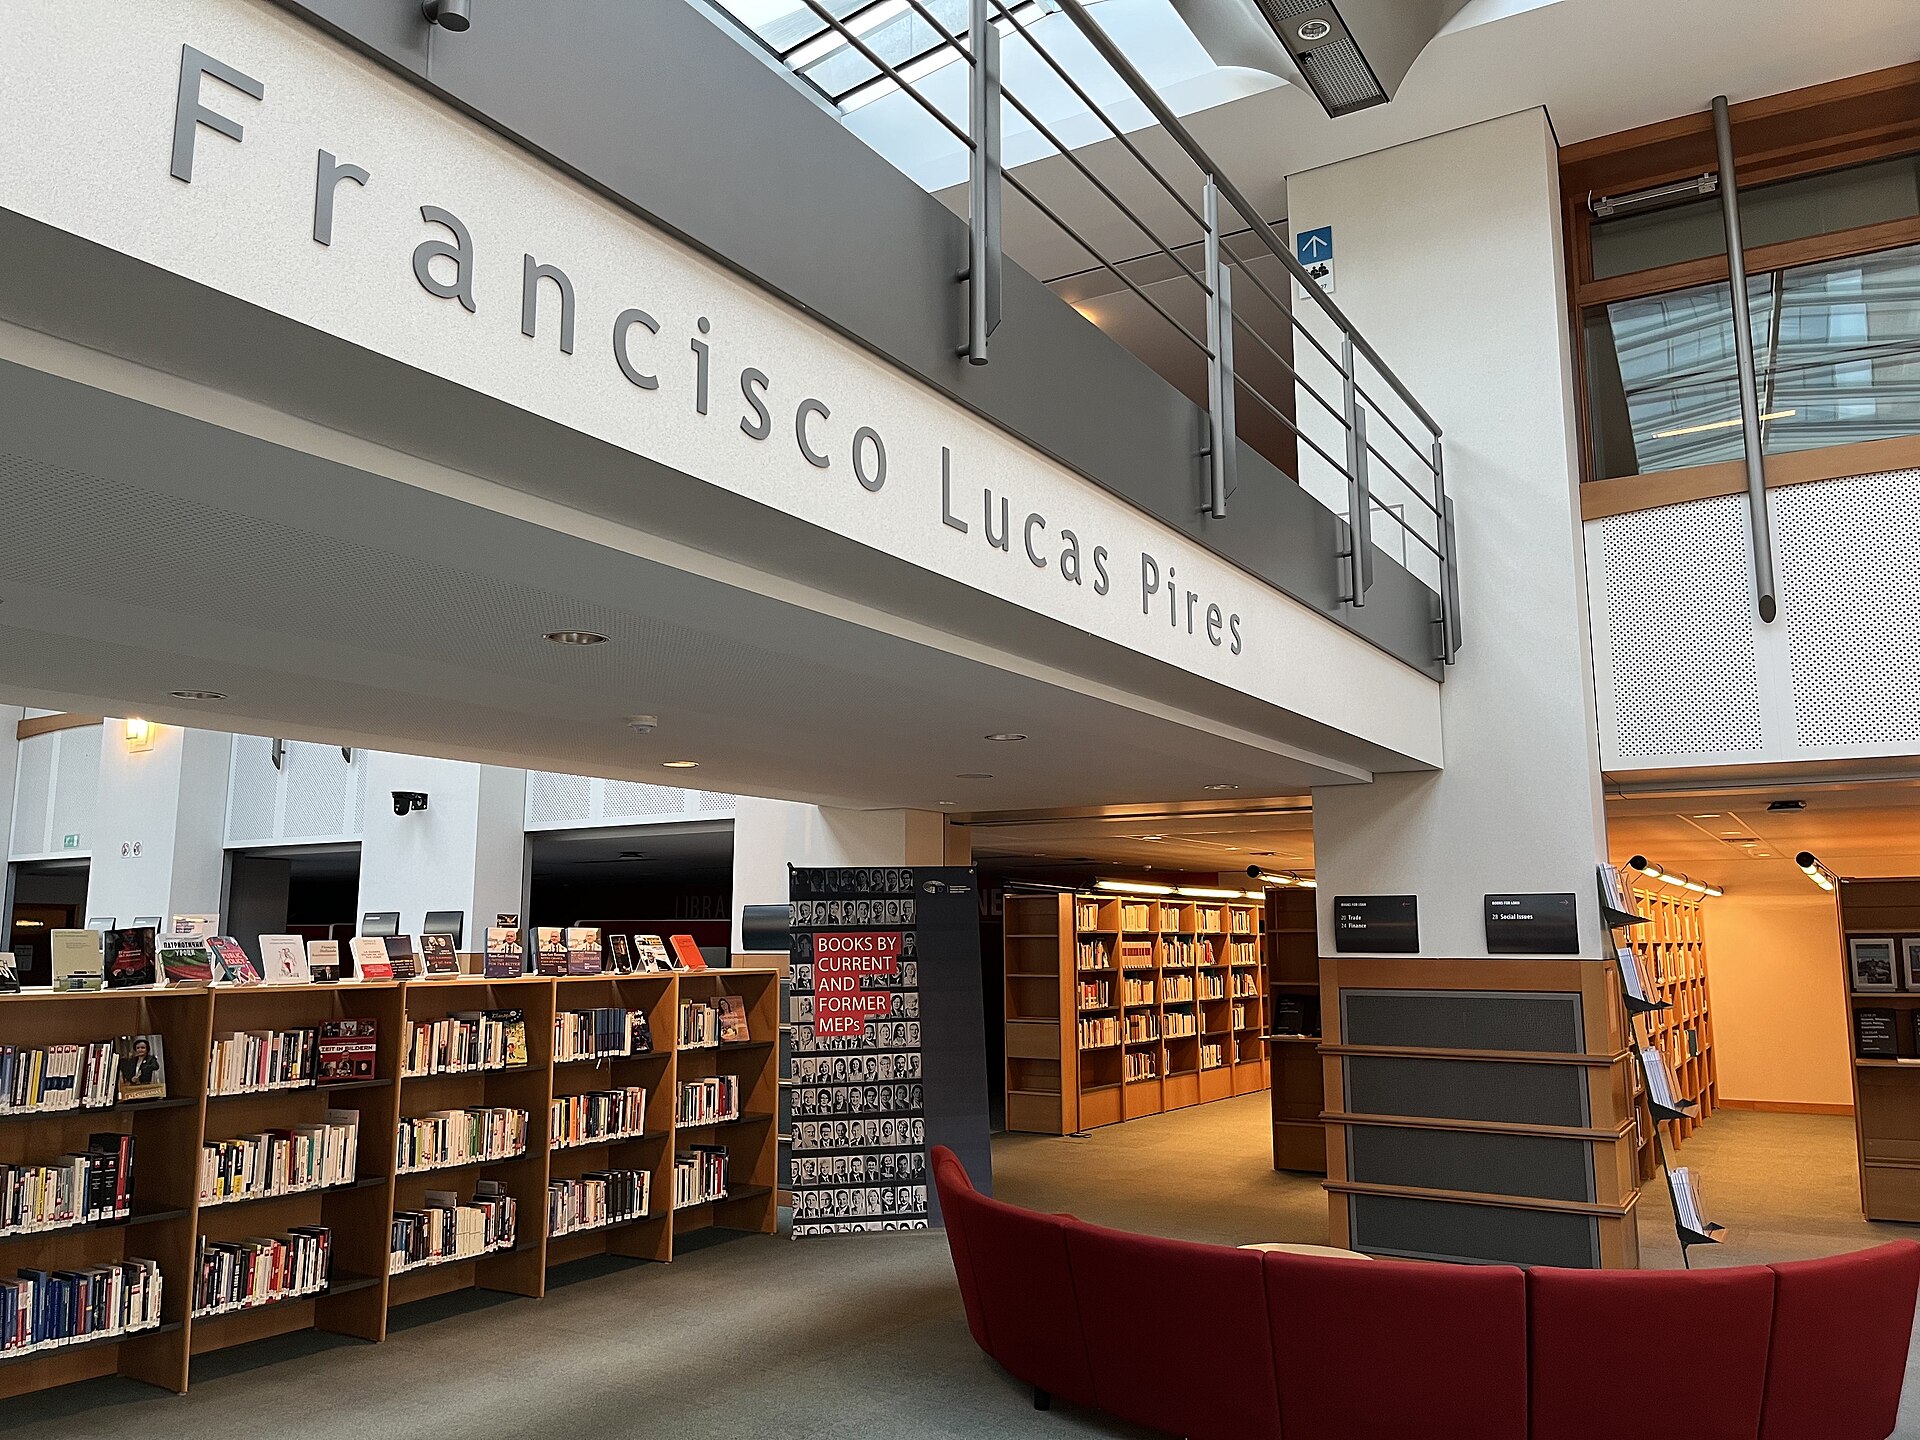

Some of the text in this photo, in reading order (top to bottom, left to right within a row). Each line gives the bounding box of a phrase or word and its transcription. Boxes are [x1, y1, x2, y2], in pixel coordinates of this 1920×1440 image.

[170, 43, 1243, 656] Francisco Lucas Pires
[674, 895, 731, 919] LIBRA
[818, 936, 897, 952] BOOKS BY
[818, 956, 893, 972] CURRENT
[819, 976, 855, 992] AND
[819, 995, 887, 1012] FORMER
[819, 1016, 861, 1033] MEPs
